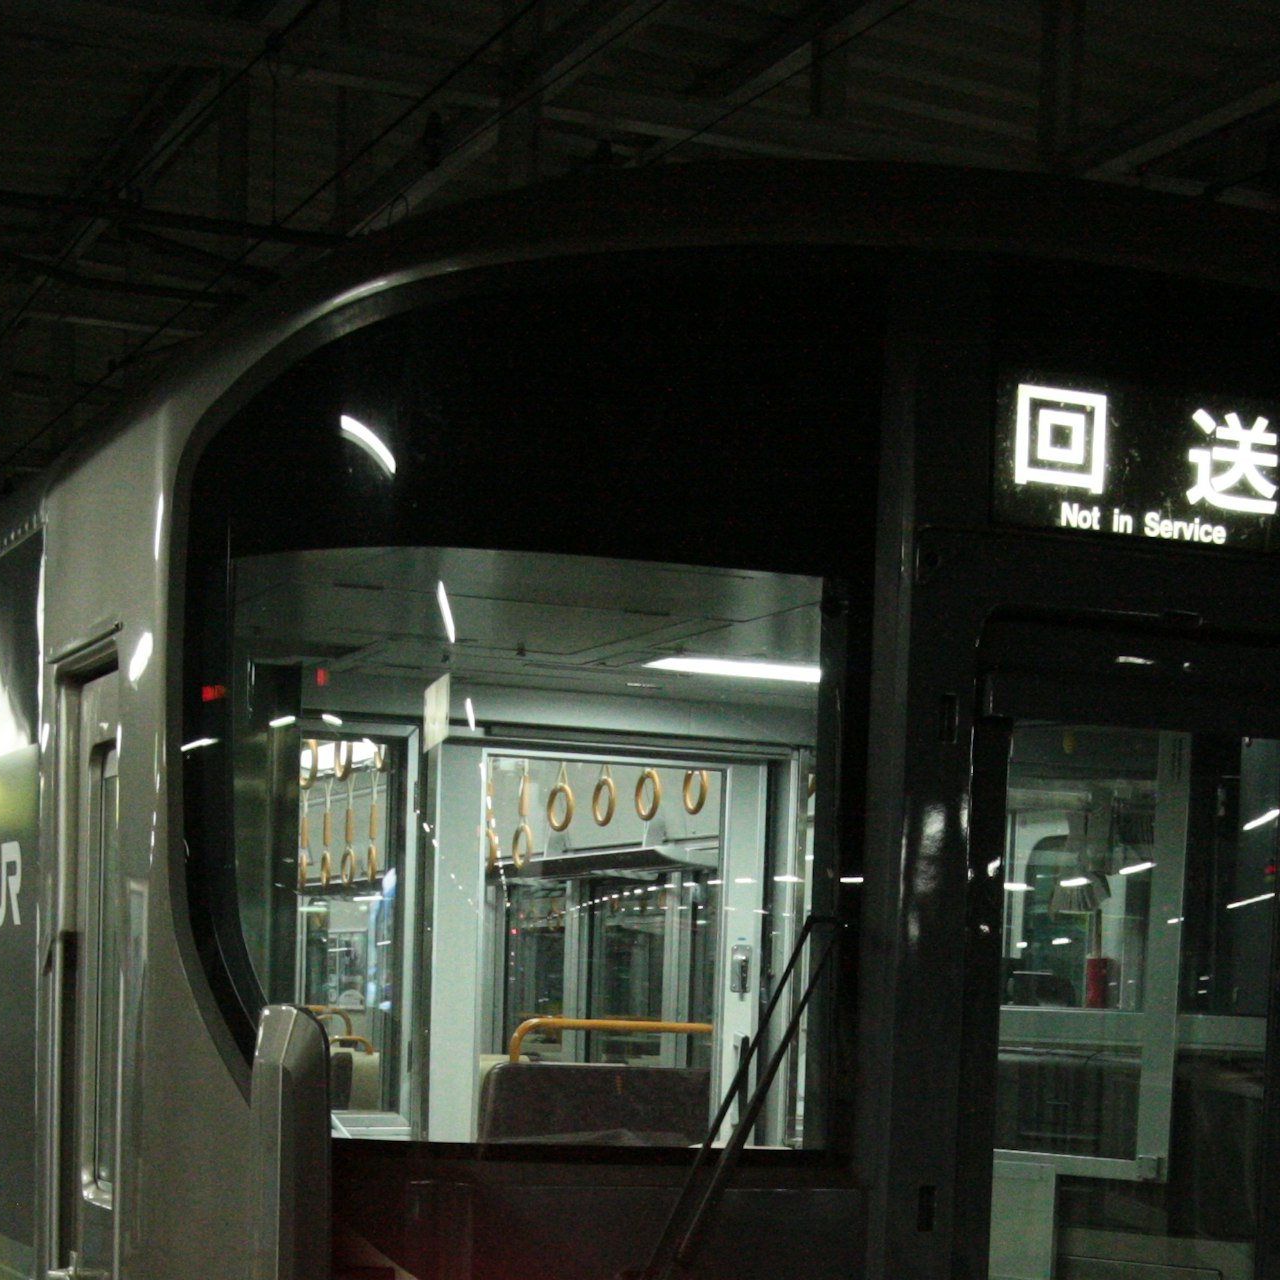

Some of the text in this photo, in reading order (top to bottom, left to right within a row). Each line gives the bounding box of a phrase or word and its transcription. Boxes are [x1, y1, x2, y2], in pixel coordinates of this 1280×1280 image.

[1015, 384, 1278, 514] 回送
[1060, 502, 1227, 545] Not in Service
